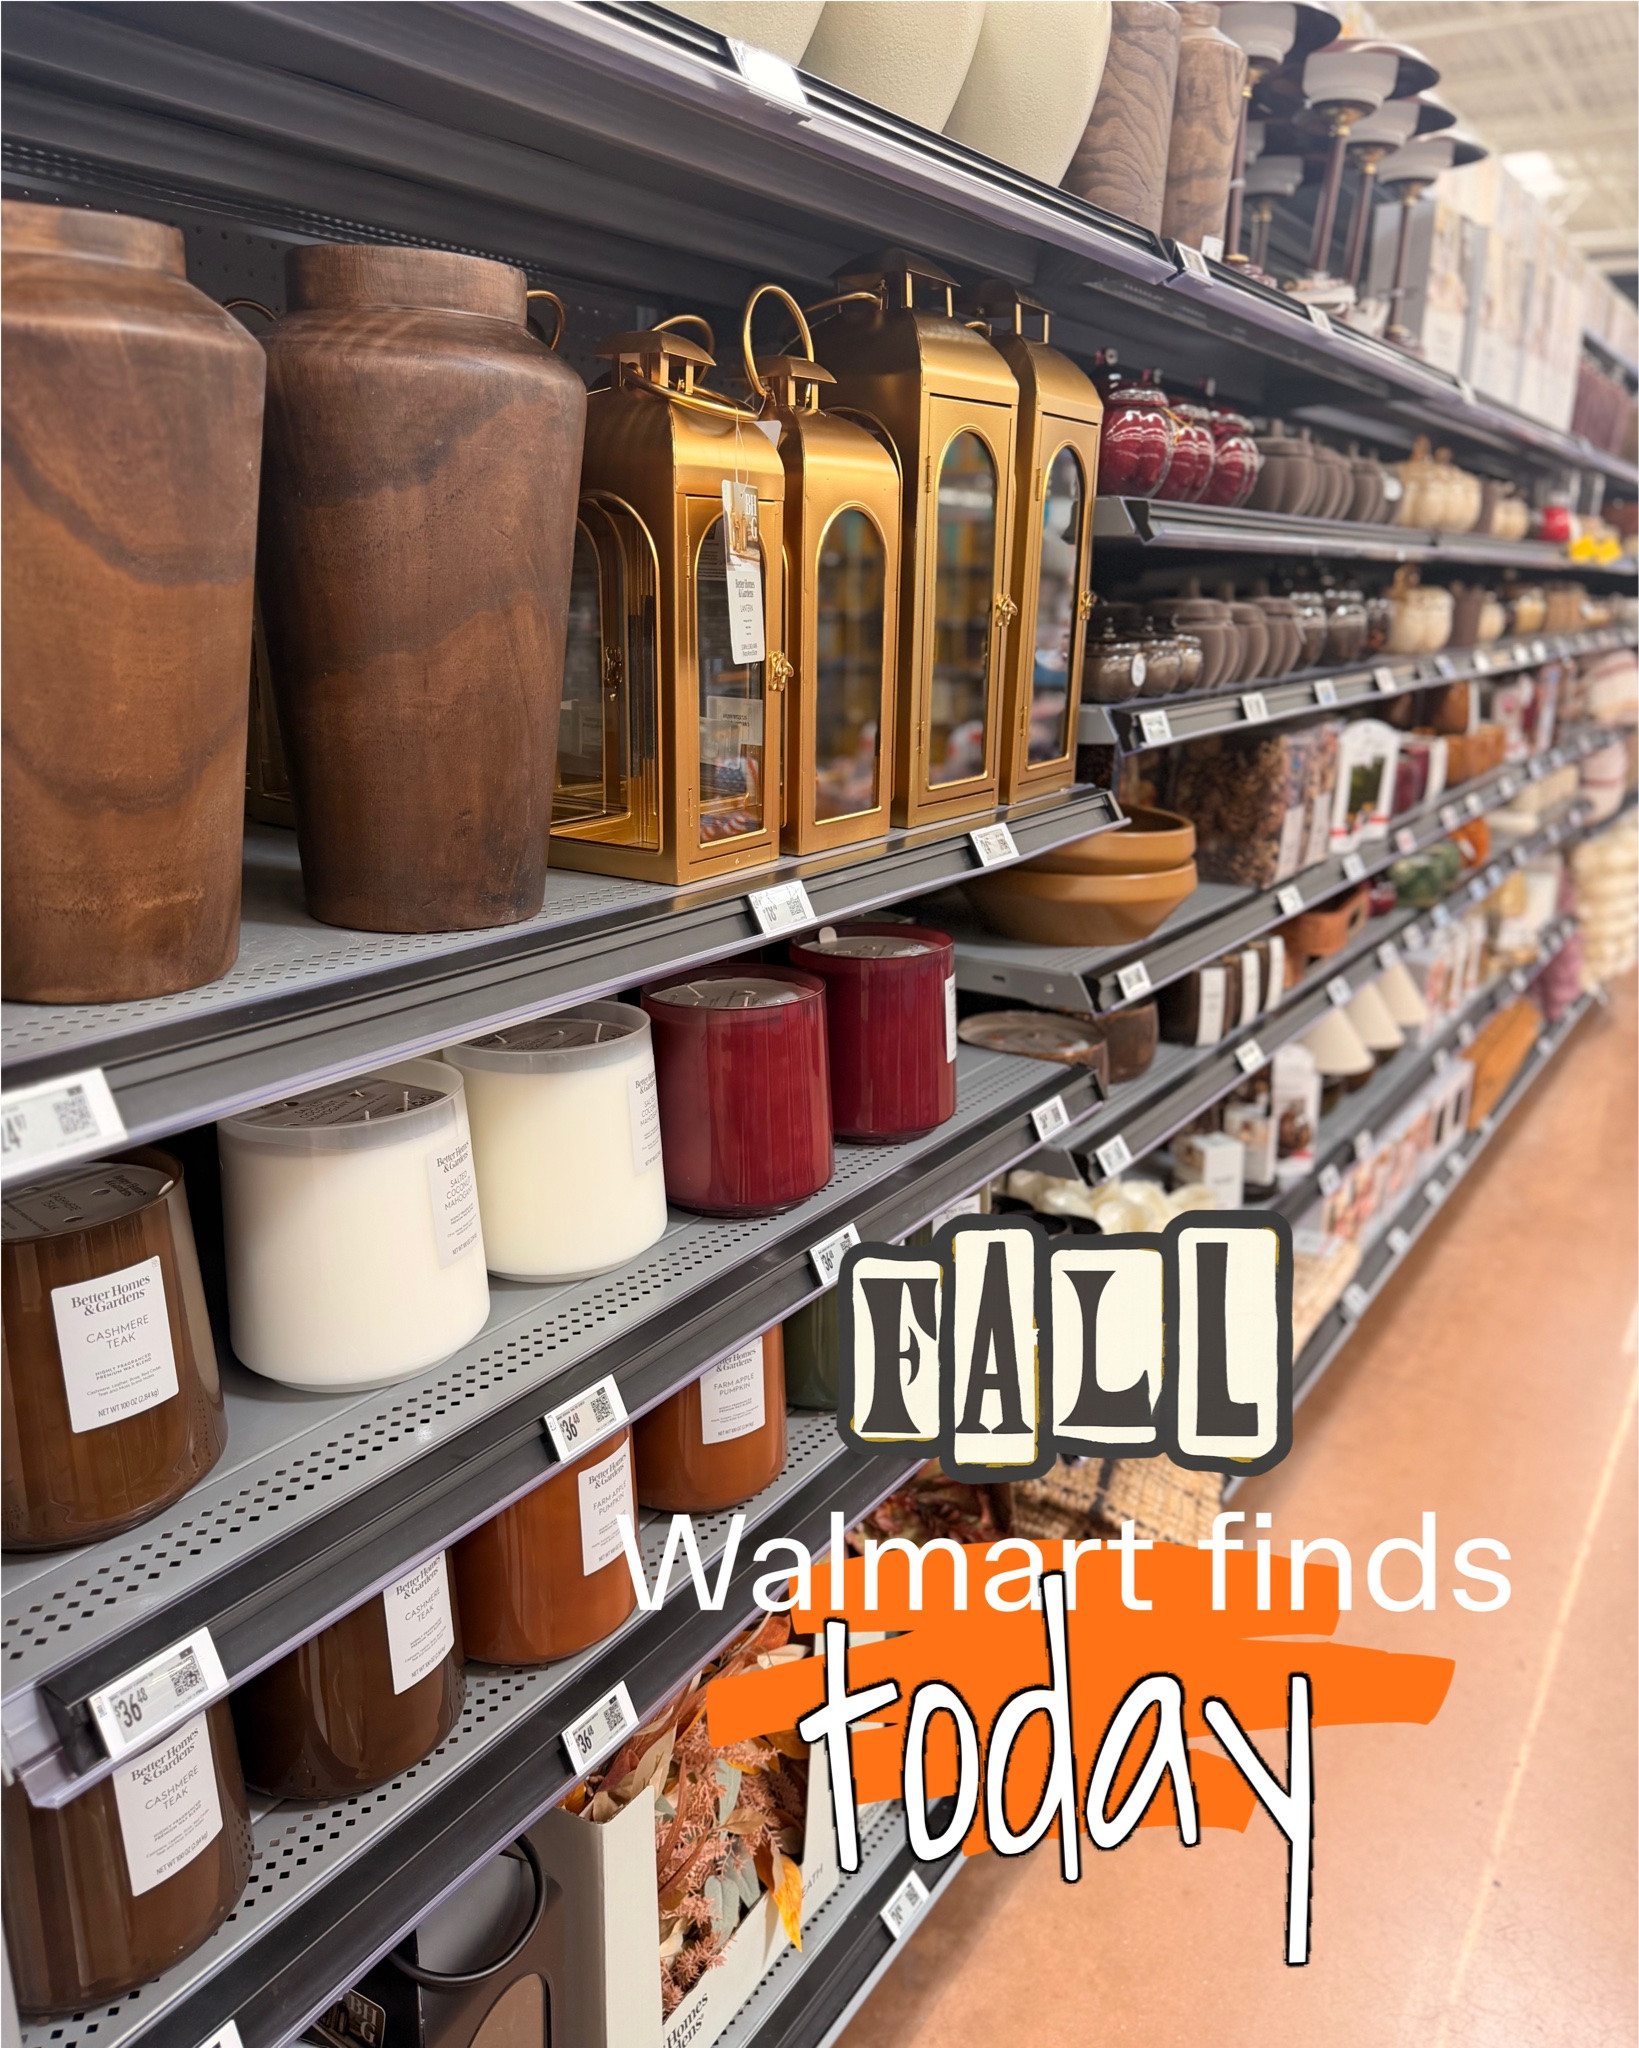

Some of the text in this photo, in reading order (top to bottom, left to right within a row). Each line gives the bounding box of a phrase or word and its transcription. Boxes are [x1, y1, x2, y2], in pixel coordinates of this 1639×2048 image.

[745, 493, 757, 516] BH
[436, 1151, 456, 1168] Better
[450, 1170, 468, 1188] SALTED
[71, 1275, 151, 1309] Better Homes
[84, 1290, 145, 1316] & Gardens
[86, 1314, 150, 1344] CASHMERE
[106, 1332, 136, 1349] TEAK
[722, 1358, 752, 1372] Gardens
[733, 1349, 757, 1362] Homes
[714, 1372, 754, 1390] FARM APPLE
[720, 1382, 750, 1396] PUMPKIN
[98, 1408, 110, 1418] NET
[110, 1404, 120, 1414] WT
[120, 1400, 130, 1410] 100
[130, 1397, 138, 1406] OZ
[588, 1467, 609, 1485] Better
[594, 1480, 628, 1510] FARM APPLE
[598, 1492, 625, 1516] PUMPKIN
[396, 1556, 440, 1596] Better Homes
[404, 1568, 438, 1600] & Gardens
[404, 1586, 440, 1621] CASHMERE
[416, 1604, 434, 1622] TEAK
[131, 1728, 199, 1782] Better Homes
[142, 1743, 195, 1786] & Gardens
[145, 1764, 199, 1810] CASHMERE
[163, 1786, 188, 1810] TEAK
[156, 1864, 166, 1875] NET
[166, 1858, 176, 1868] WT
[802, 1863, 823, 1899] EATH
[349, 1994, 378, 2027] BH
[361, 2021, 376, 2043] G
